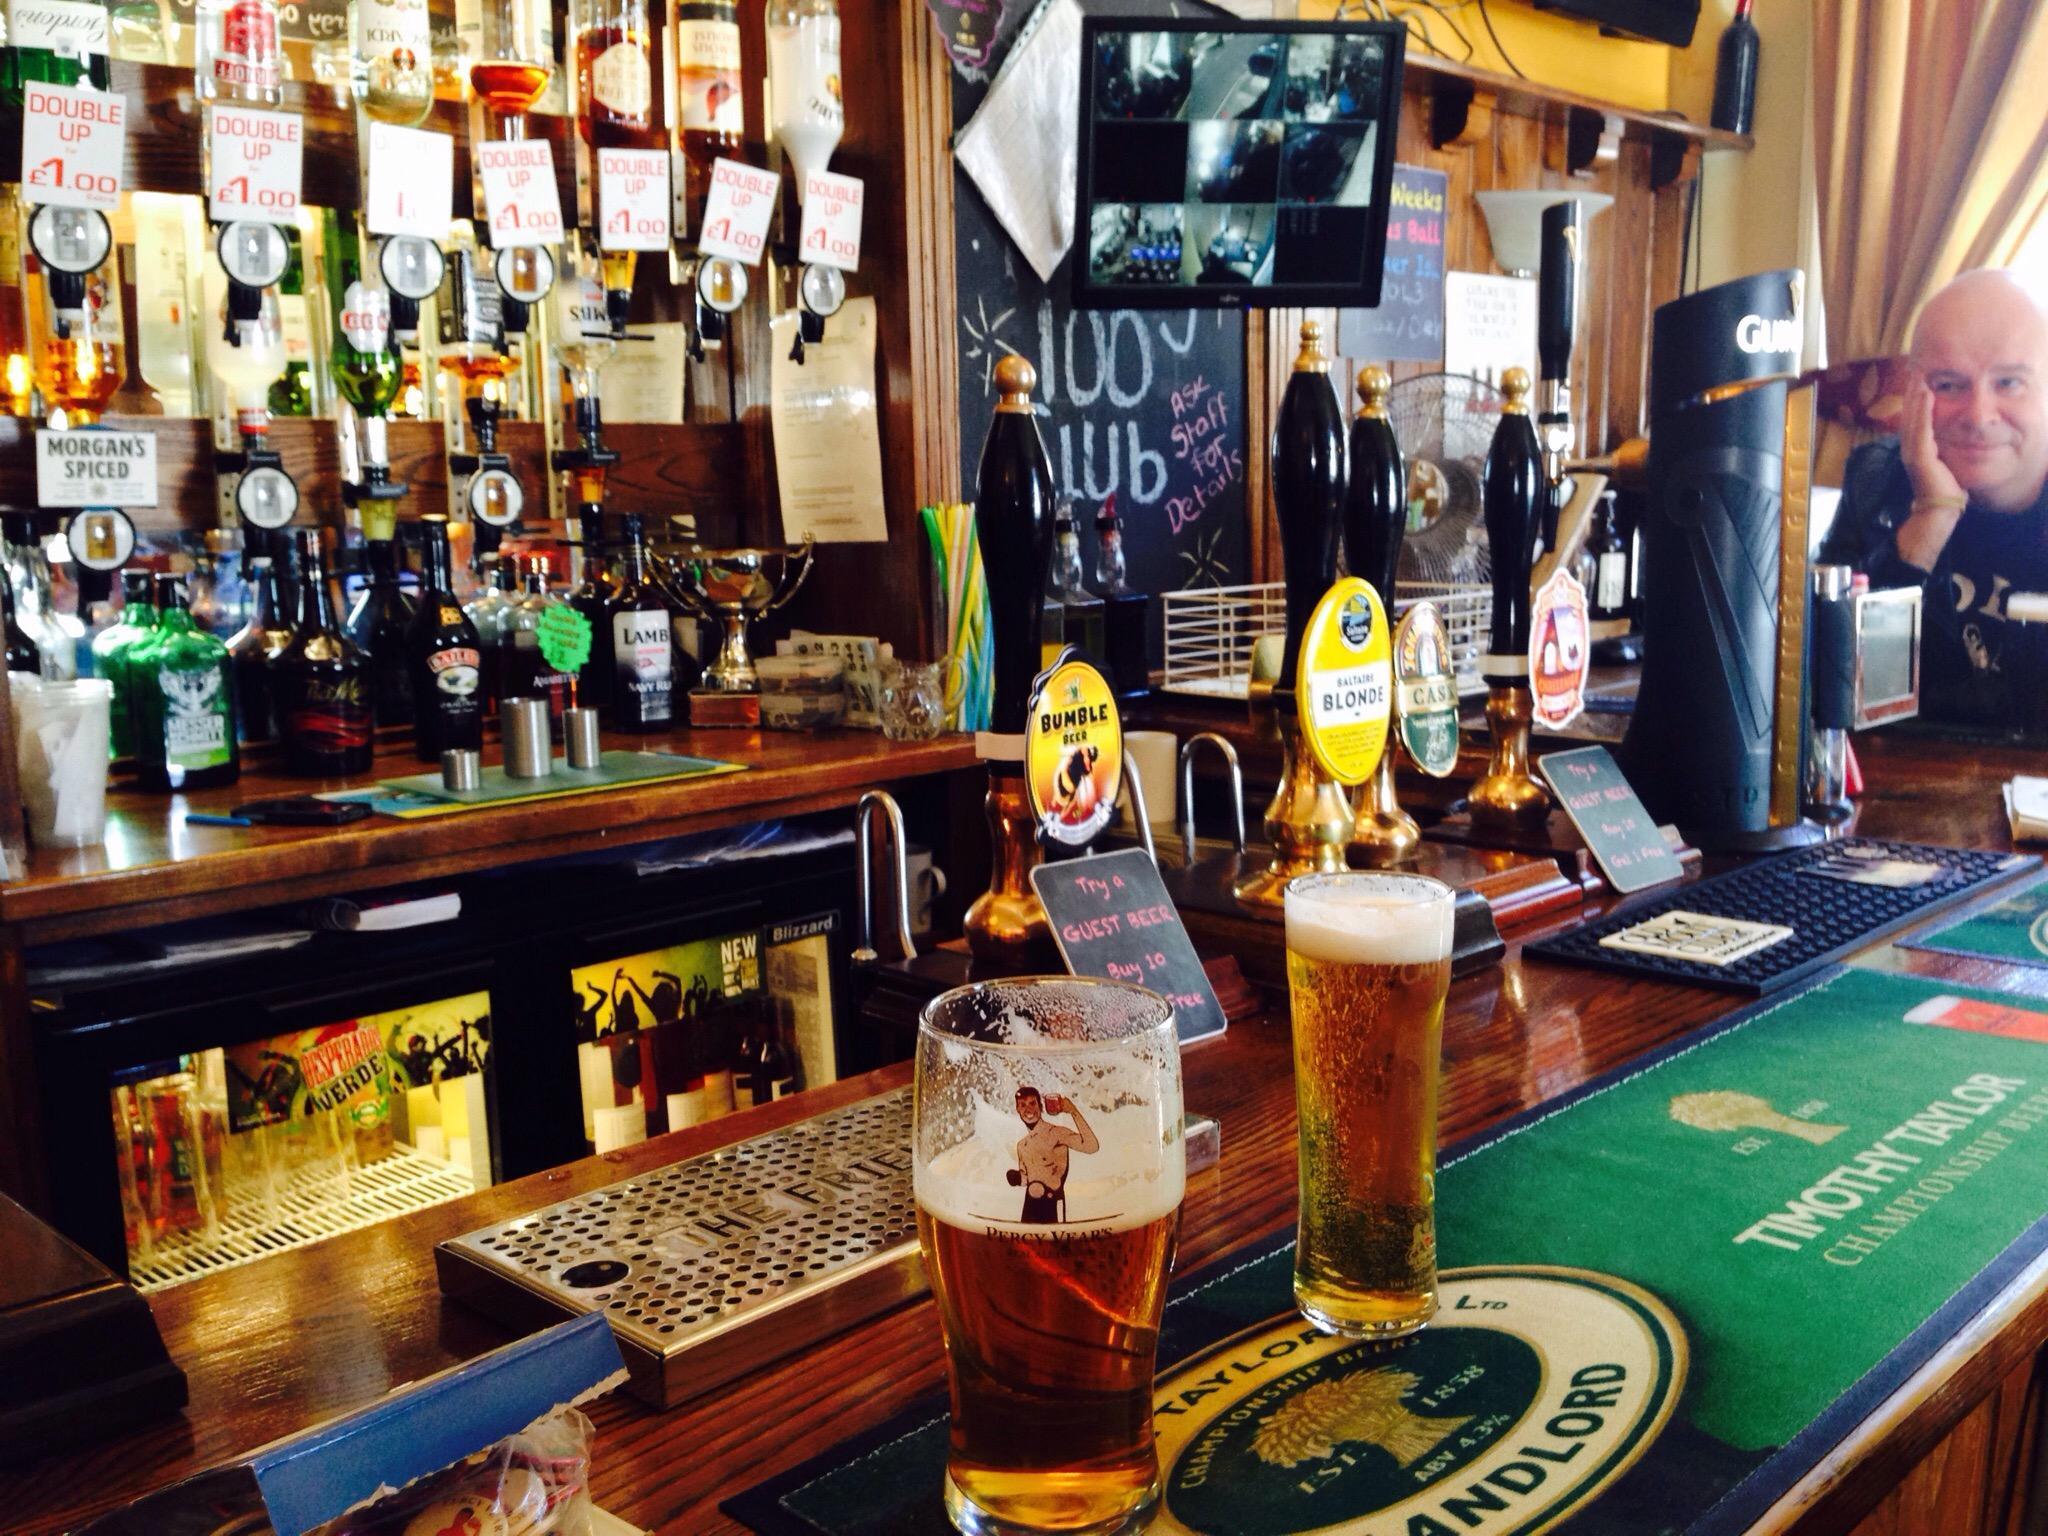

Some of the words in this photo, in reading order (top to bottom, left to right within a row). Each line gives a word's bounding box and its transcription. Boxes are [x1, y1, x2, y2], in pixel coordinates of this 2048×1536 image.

[29, 92, 122, 125] DOUBLE
[59, 121, 91, 143] UP
[216, 115, 298, 143] DOUBLE
[243, 142, 272, 161] UP
[482, 149, 549, 169] DOUBLE
[603, 156, 666, 177] DOUBLE
[28, 157, 118, 194] £1.00
[507, 170, 531, 188] UP
[624, 177, 647, 196] UP
[716, 167, 774, 197] DOUBLE
[217, 175, 297, 209] £1.00
[730, 192, 753, 208] UP
[807, 178, 860, 206] DOUBLE
[495, 201, 559, 231] £1.00
[606, 207, 667, 236] £1.00
[824, 201, 843, 217] UP
[706, 217, 762, 250] £1.00
[806, 226, 857, 258] £1.00
[1170, 390, 1230, 459] Staff
[46, 434, 146, 458] MORGAN'S
[64, 459, 130, 480] SPICED
[1164, 448, 1244, 536] Details
[1336, 673, 1375, 689] SALTAIRE
[1322, 686, 1384, 712] BLONDE
[1040, 702, 1108, 734] BUMBLE
[1062, 730, 1088, 746] BEER
[1074, 875, 1112, 900] Try
[1112, 874, 1126, 889] a
[772, 915, 833, 941] Blizzard
[1062, 914, 1121, 943] GUEST
[1126, 904, 1175, 929] BEER
[721, 933, 757, 965] NEW
[1106, 961, 1145, 985] Buy
[1144, 951, 1167, 970] 10
[319, 1055, 384, 1112] VERDE
[1731, 1140, 1923, 1252] TIMOTHY
[1883, 1071, 2028, 1147] TAYLOR
[1822, 1129, 2015, 1268] CHAMPIONSHIP
[664, 1202, 790, 1248] THE
[985, 1225, 1047, 1246] PERCY
[1421, 1364, 1486, 1408] 1858
[1180, 1362, 1322, 1489] CHAMPIONSHIP
[1413, 1449, 1457, 1484] ABV
